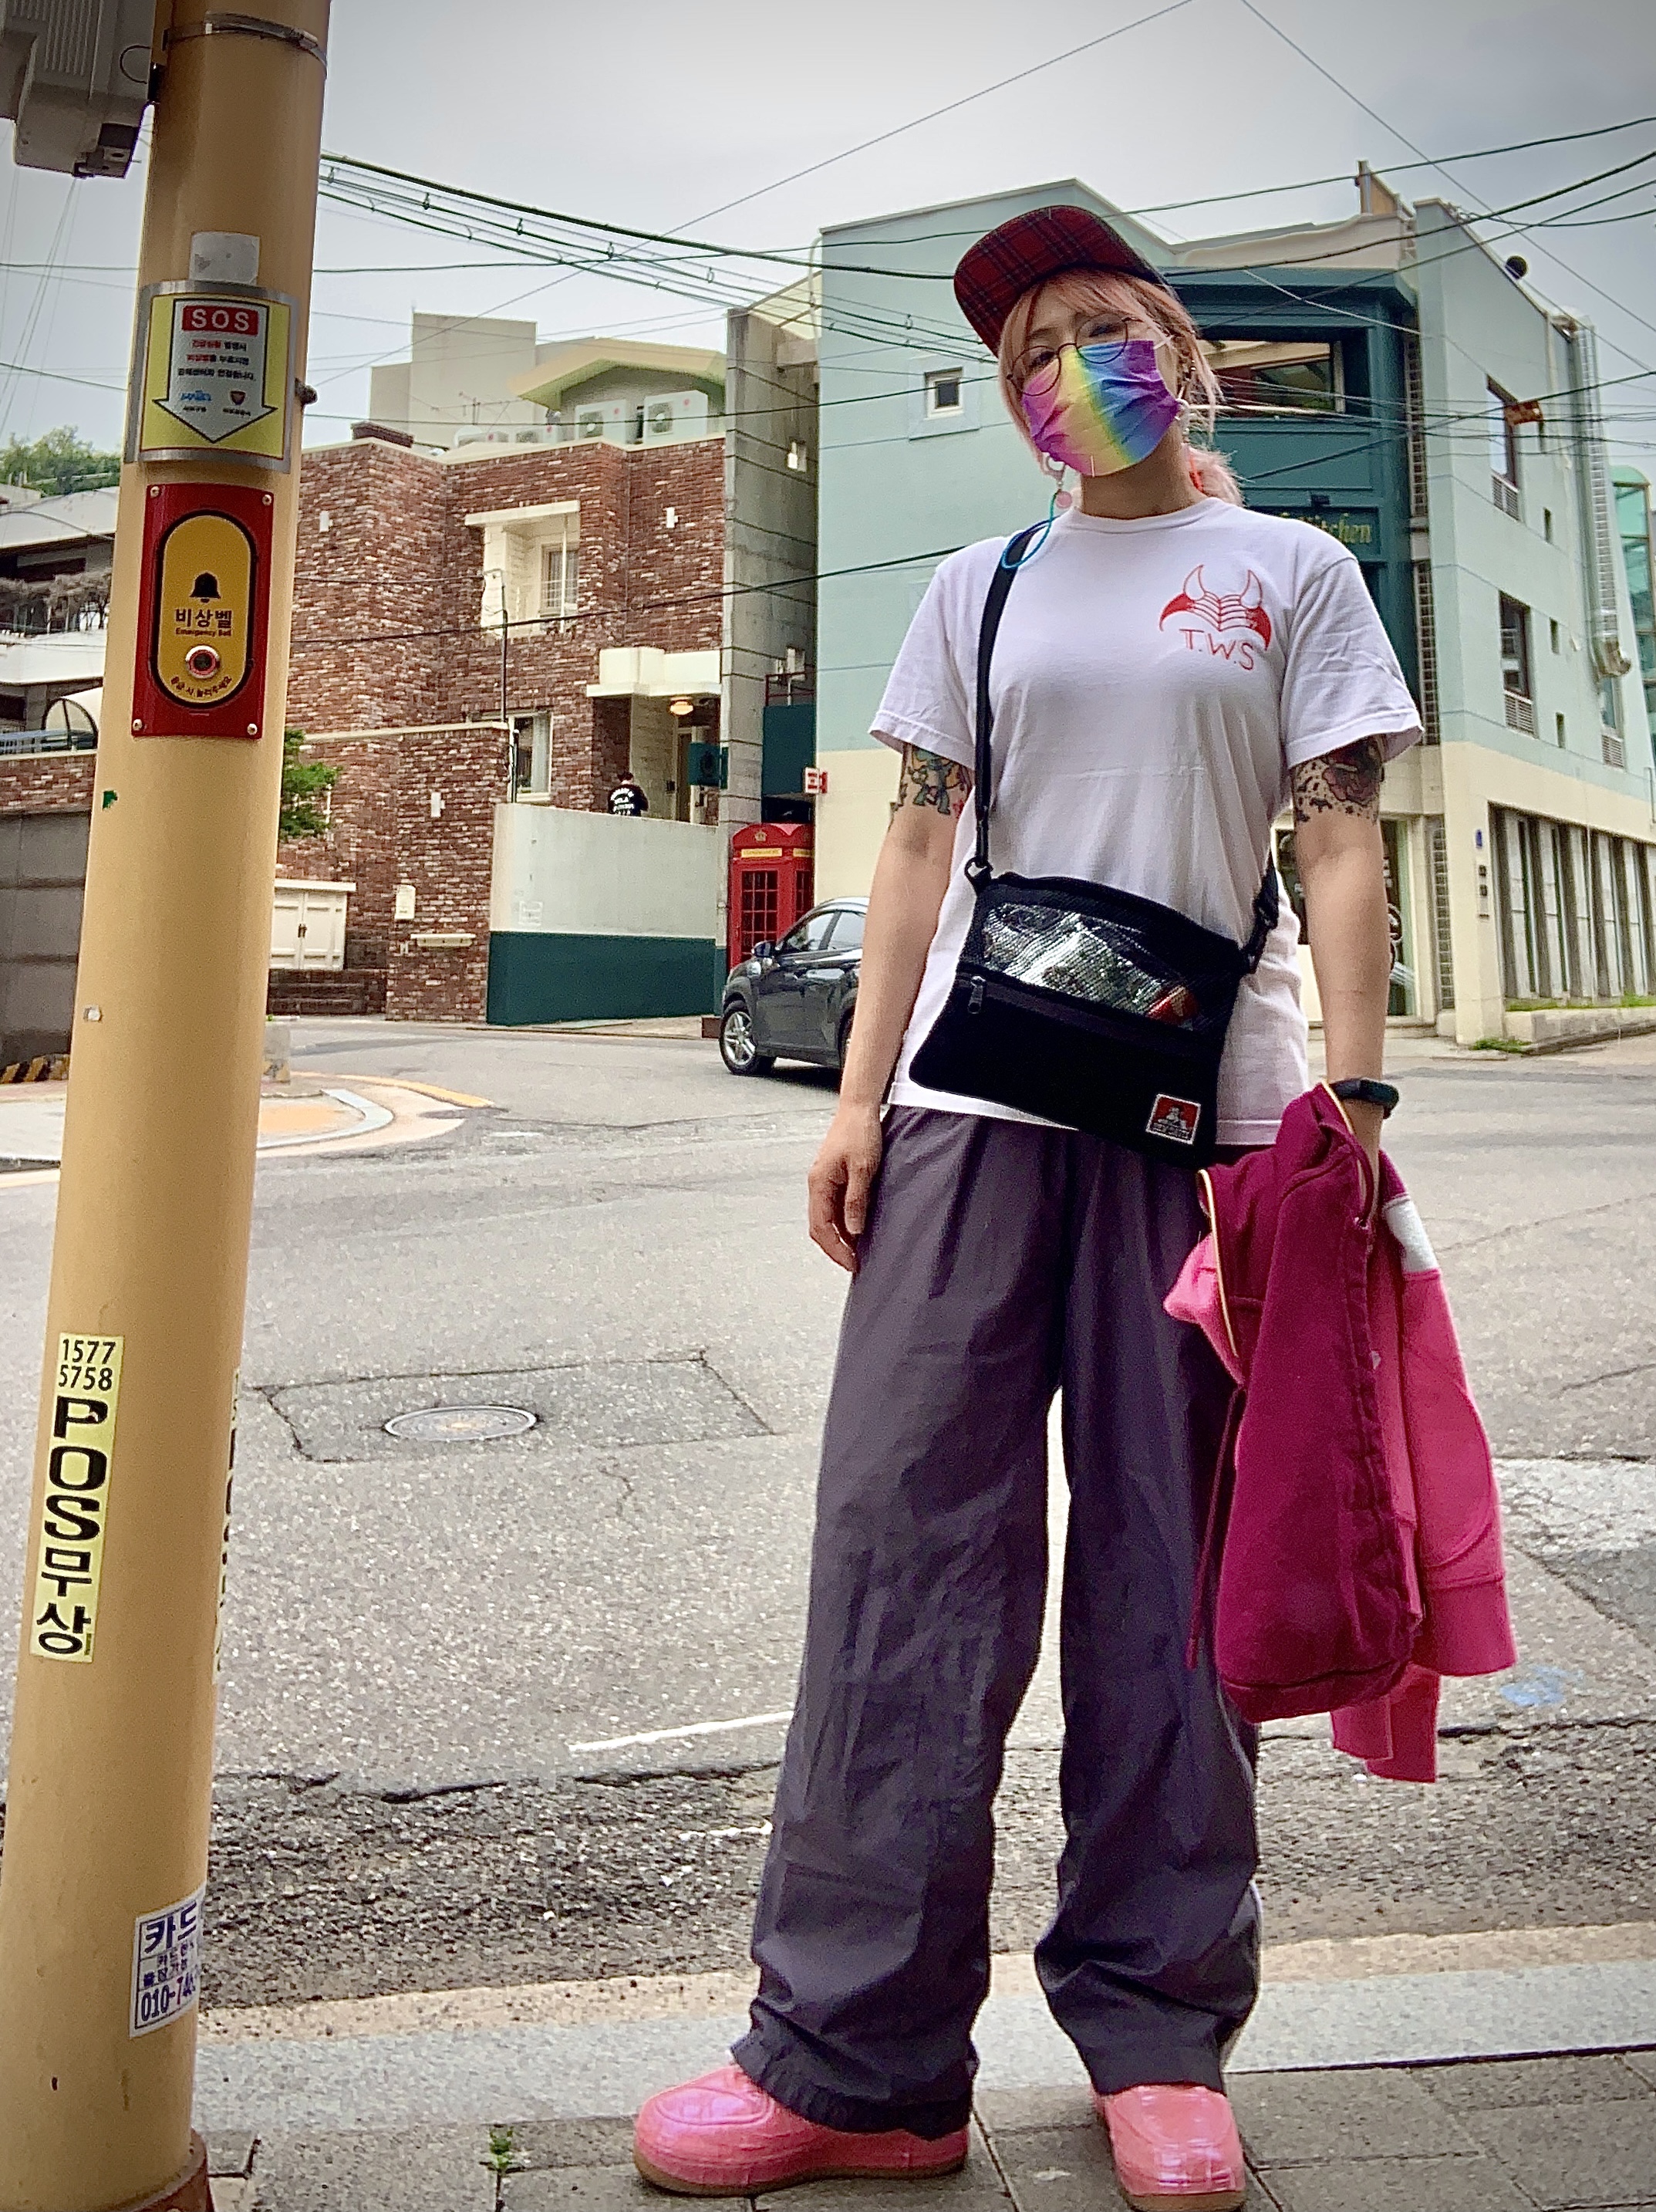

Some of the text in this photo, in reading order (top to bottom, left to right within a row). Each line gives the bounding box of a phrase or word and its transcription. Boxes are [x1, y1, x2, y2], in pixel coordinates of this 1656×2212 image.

[191, 308, 249, 332] SOS
[175, 608, 232, 629] 비상벨
[175, 627, 232, 637] Emergency Bell
[62, 1338, 116, 1365] 1577
[58, 1364, 113, 1391] 5758
[144, 1901, 197, 1954] 카드
